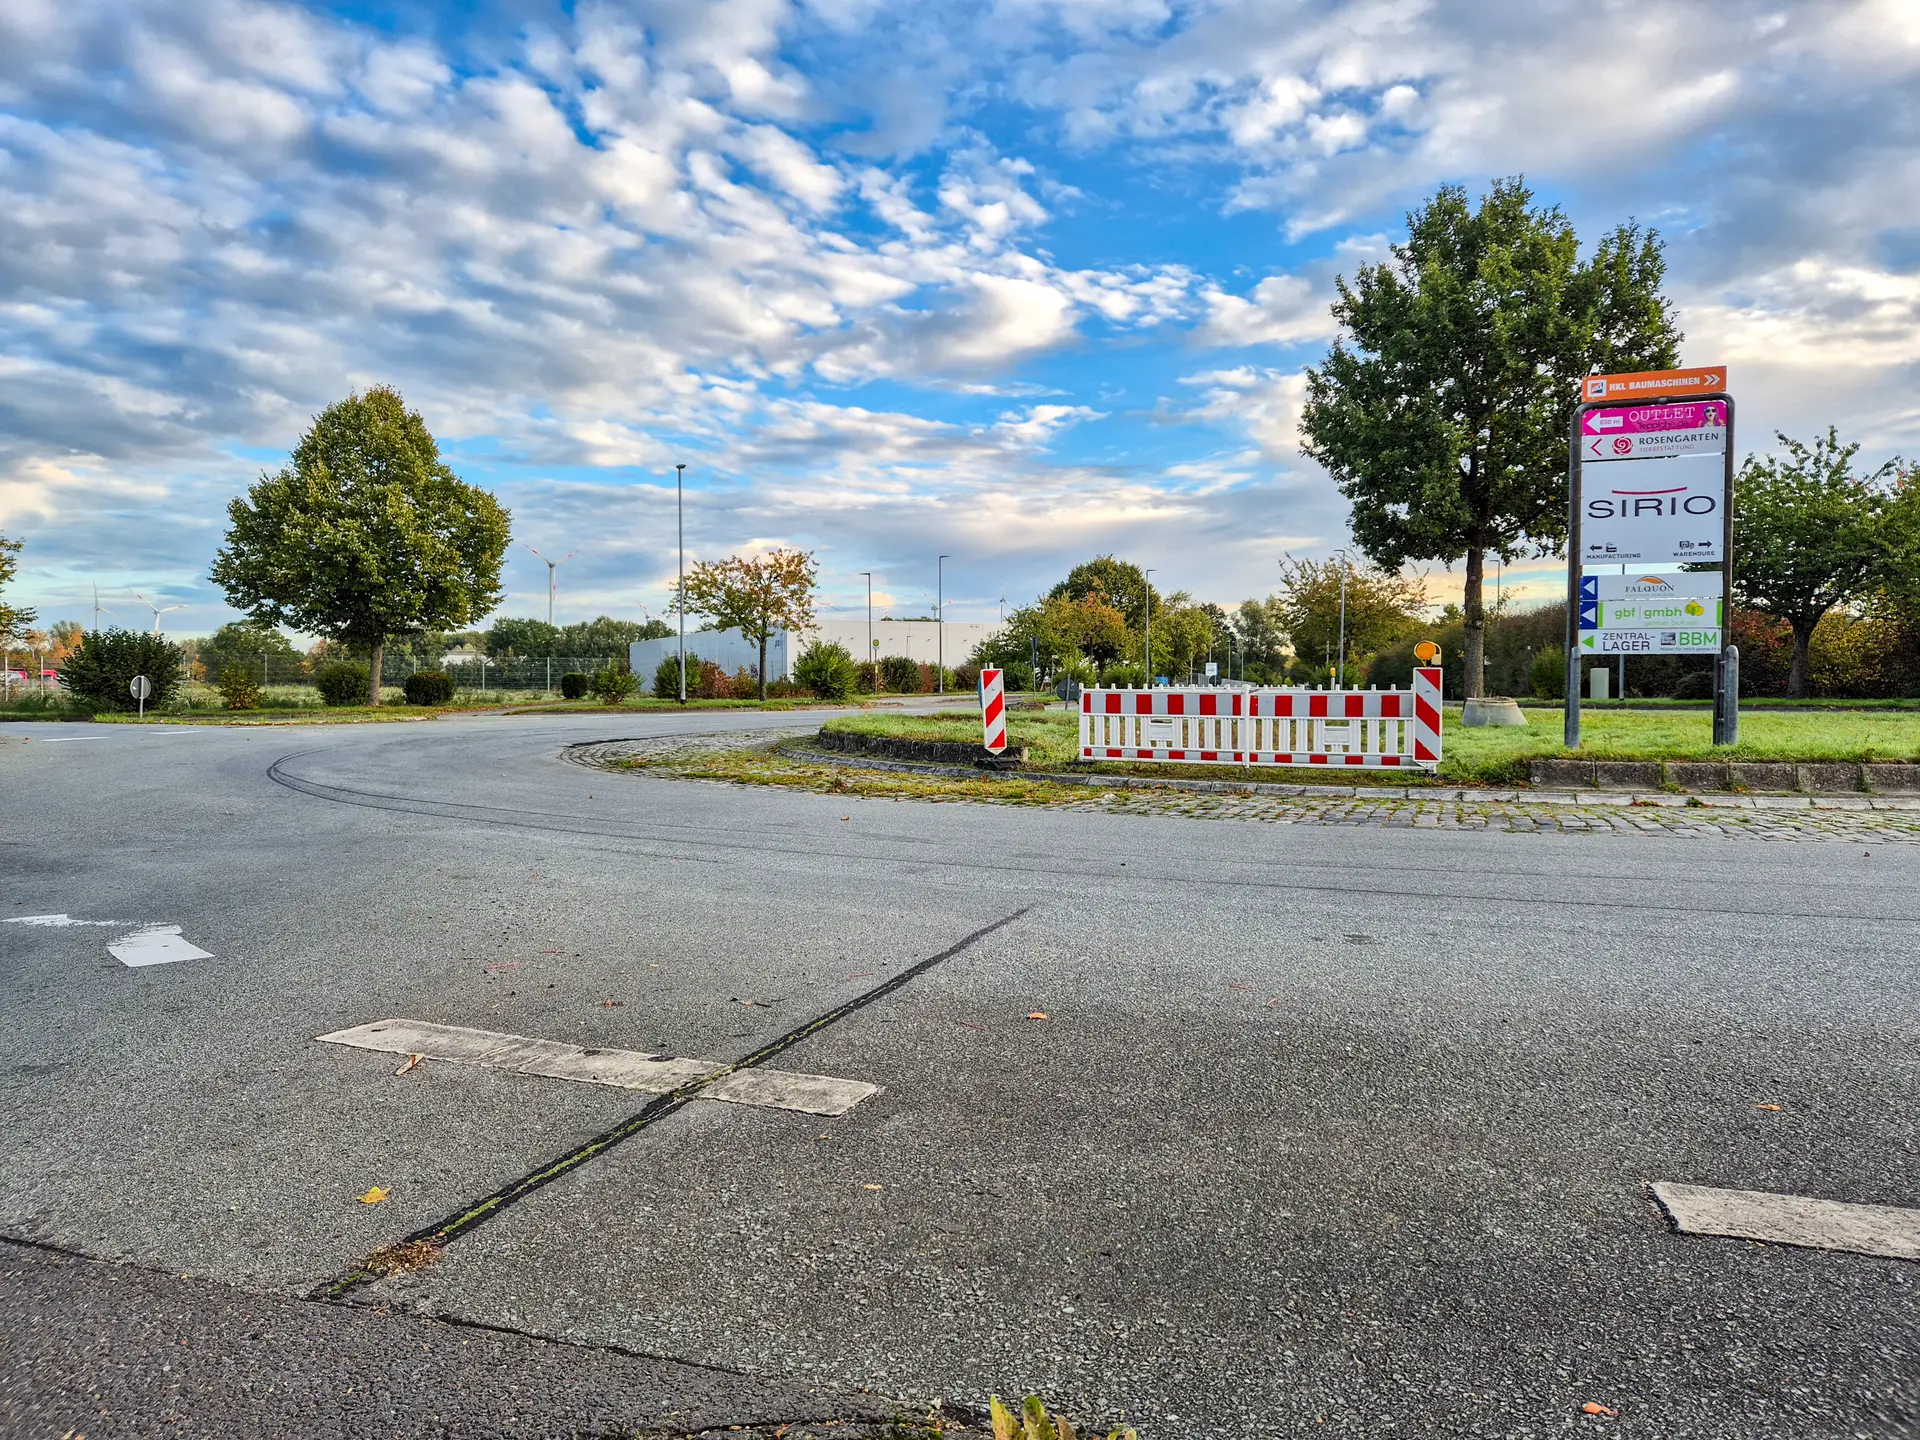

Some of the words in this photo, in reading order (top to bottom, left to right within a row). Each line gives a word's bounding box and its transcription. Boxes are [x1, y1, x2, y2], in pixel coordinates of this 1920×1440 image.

[1609, 383, 1626, 391] HKL
[1629, 377, 1701, 390] BAUMASCHINEN
[1628, 406, 1696, 422] OUTLET
[1639, 433, 1719, 445] ROSENGARTEN
[1639, 444, 1695, 453] TIERBESTATTUNG
[1588, 495, 1716, 519] SIRIO
[1625, 585, 1675, 593] FALQUON
[1615, 607, 1637, 619] gbf
[1644, 607, 1682, 619] gmbh
[1602, 632, 1656, 640] ZENTRAL-
[1679, 632, 1717, 646] BBM
[1602, 641, 1650, 651] LAGER
